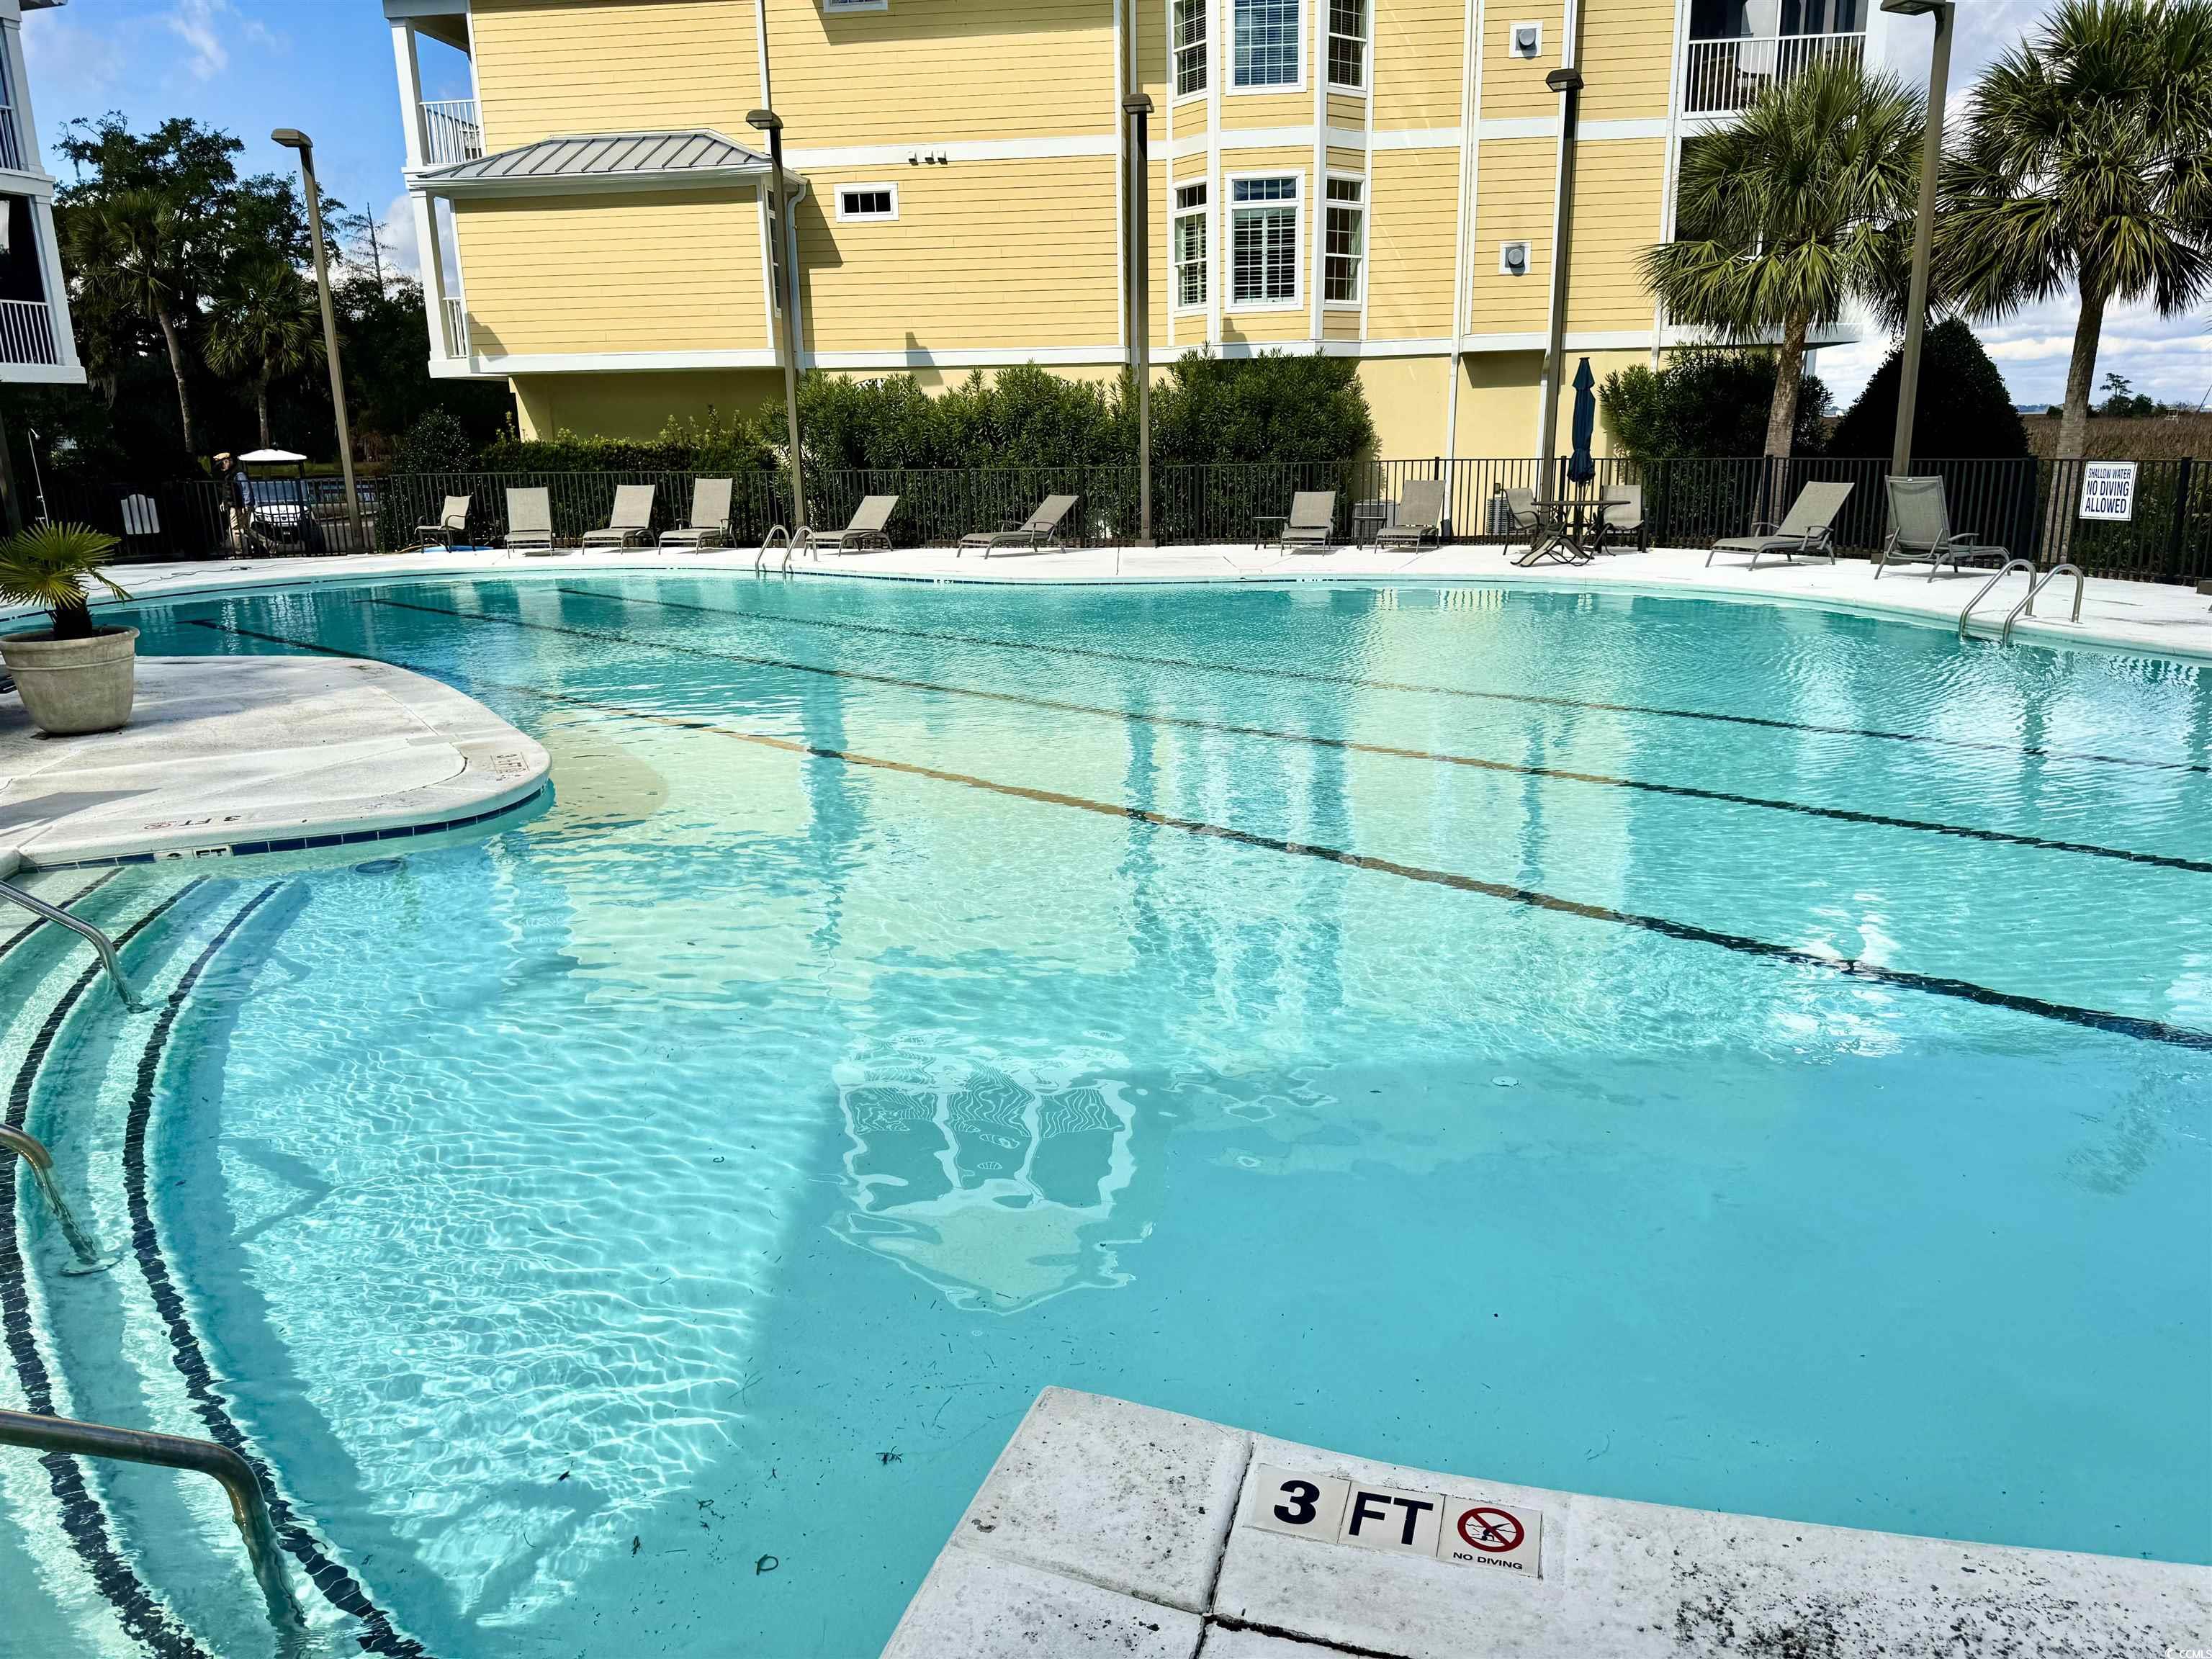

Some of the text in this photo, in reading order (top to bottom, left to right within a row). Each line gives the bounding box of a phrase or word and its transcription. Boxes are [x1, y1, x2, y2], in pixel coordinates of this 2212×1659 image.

[2088, 468, 2131, 480] SHALLOW WATER
[2086, 480, 2129, 497] NO DIVING
[2085, 498, 2127, 513] ALLOWED
[195, 848, 227, 859] FT
[1273, 1480, 1434, 1546] 3 FT
[1453, 1552, 1523, 1570] NO DIVING
